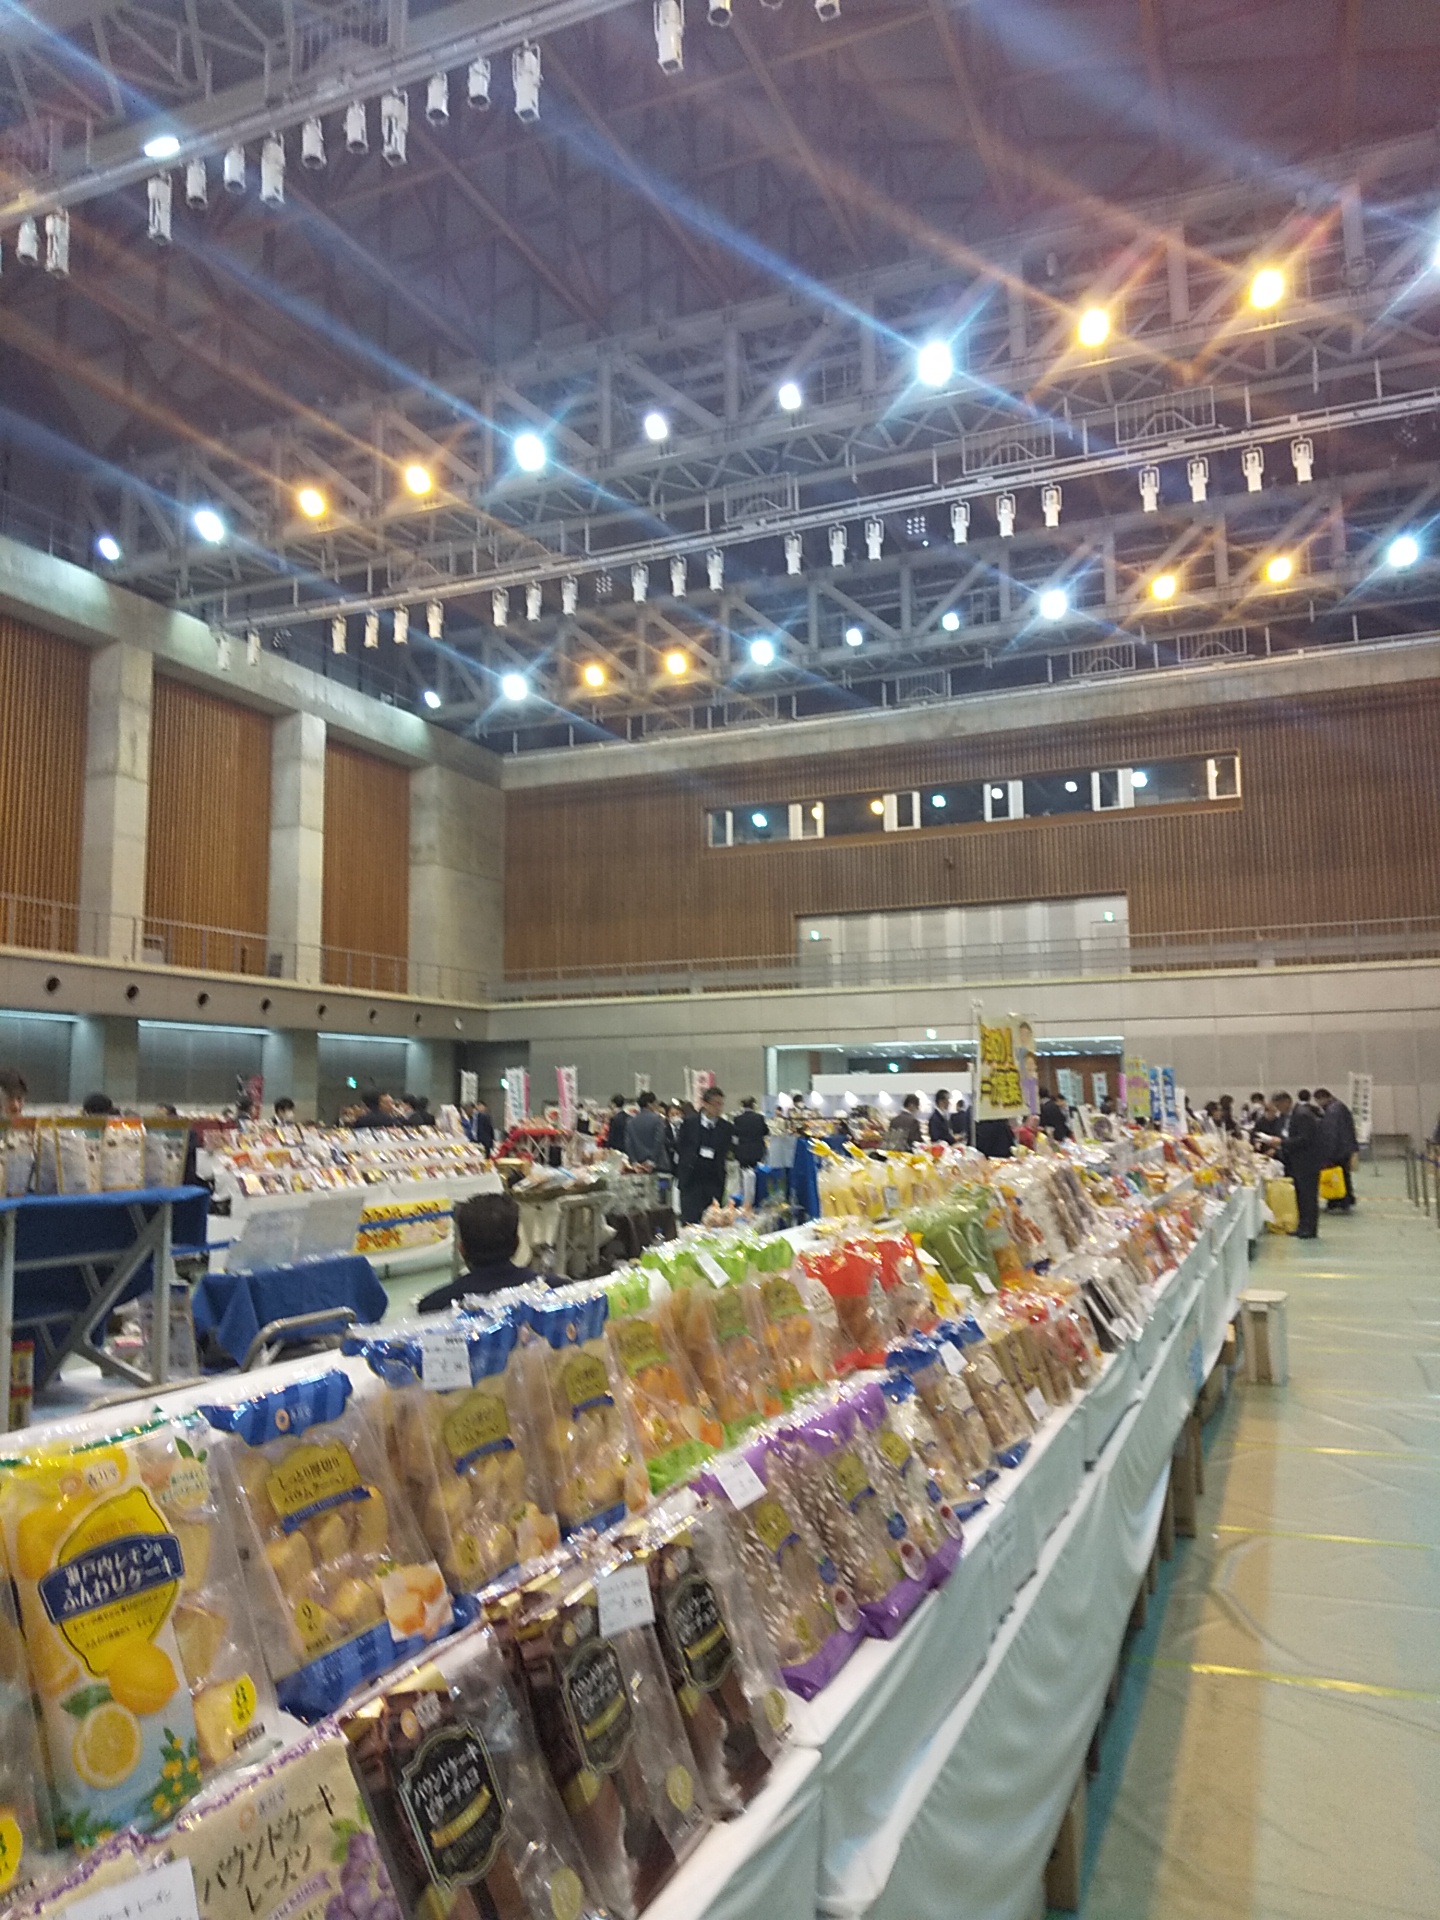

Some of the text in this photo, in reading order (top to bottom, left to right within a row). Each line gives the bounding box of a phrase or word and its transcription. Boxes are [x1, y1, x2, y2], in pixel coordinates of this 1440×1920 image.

[62, 1554, 175, 1613] ふんわりケーキ
[203, 1783, 336, 1905] パウンドケーキ
[245, 1845, 311, 1914] レーズン
